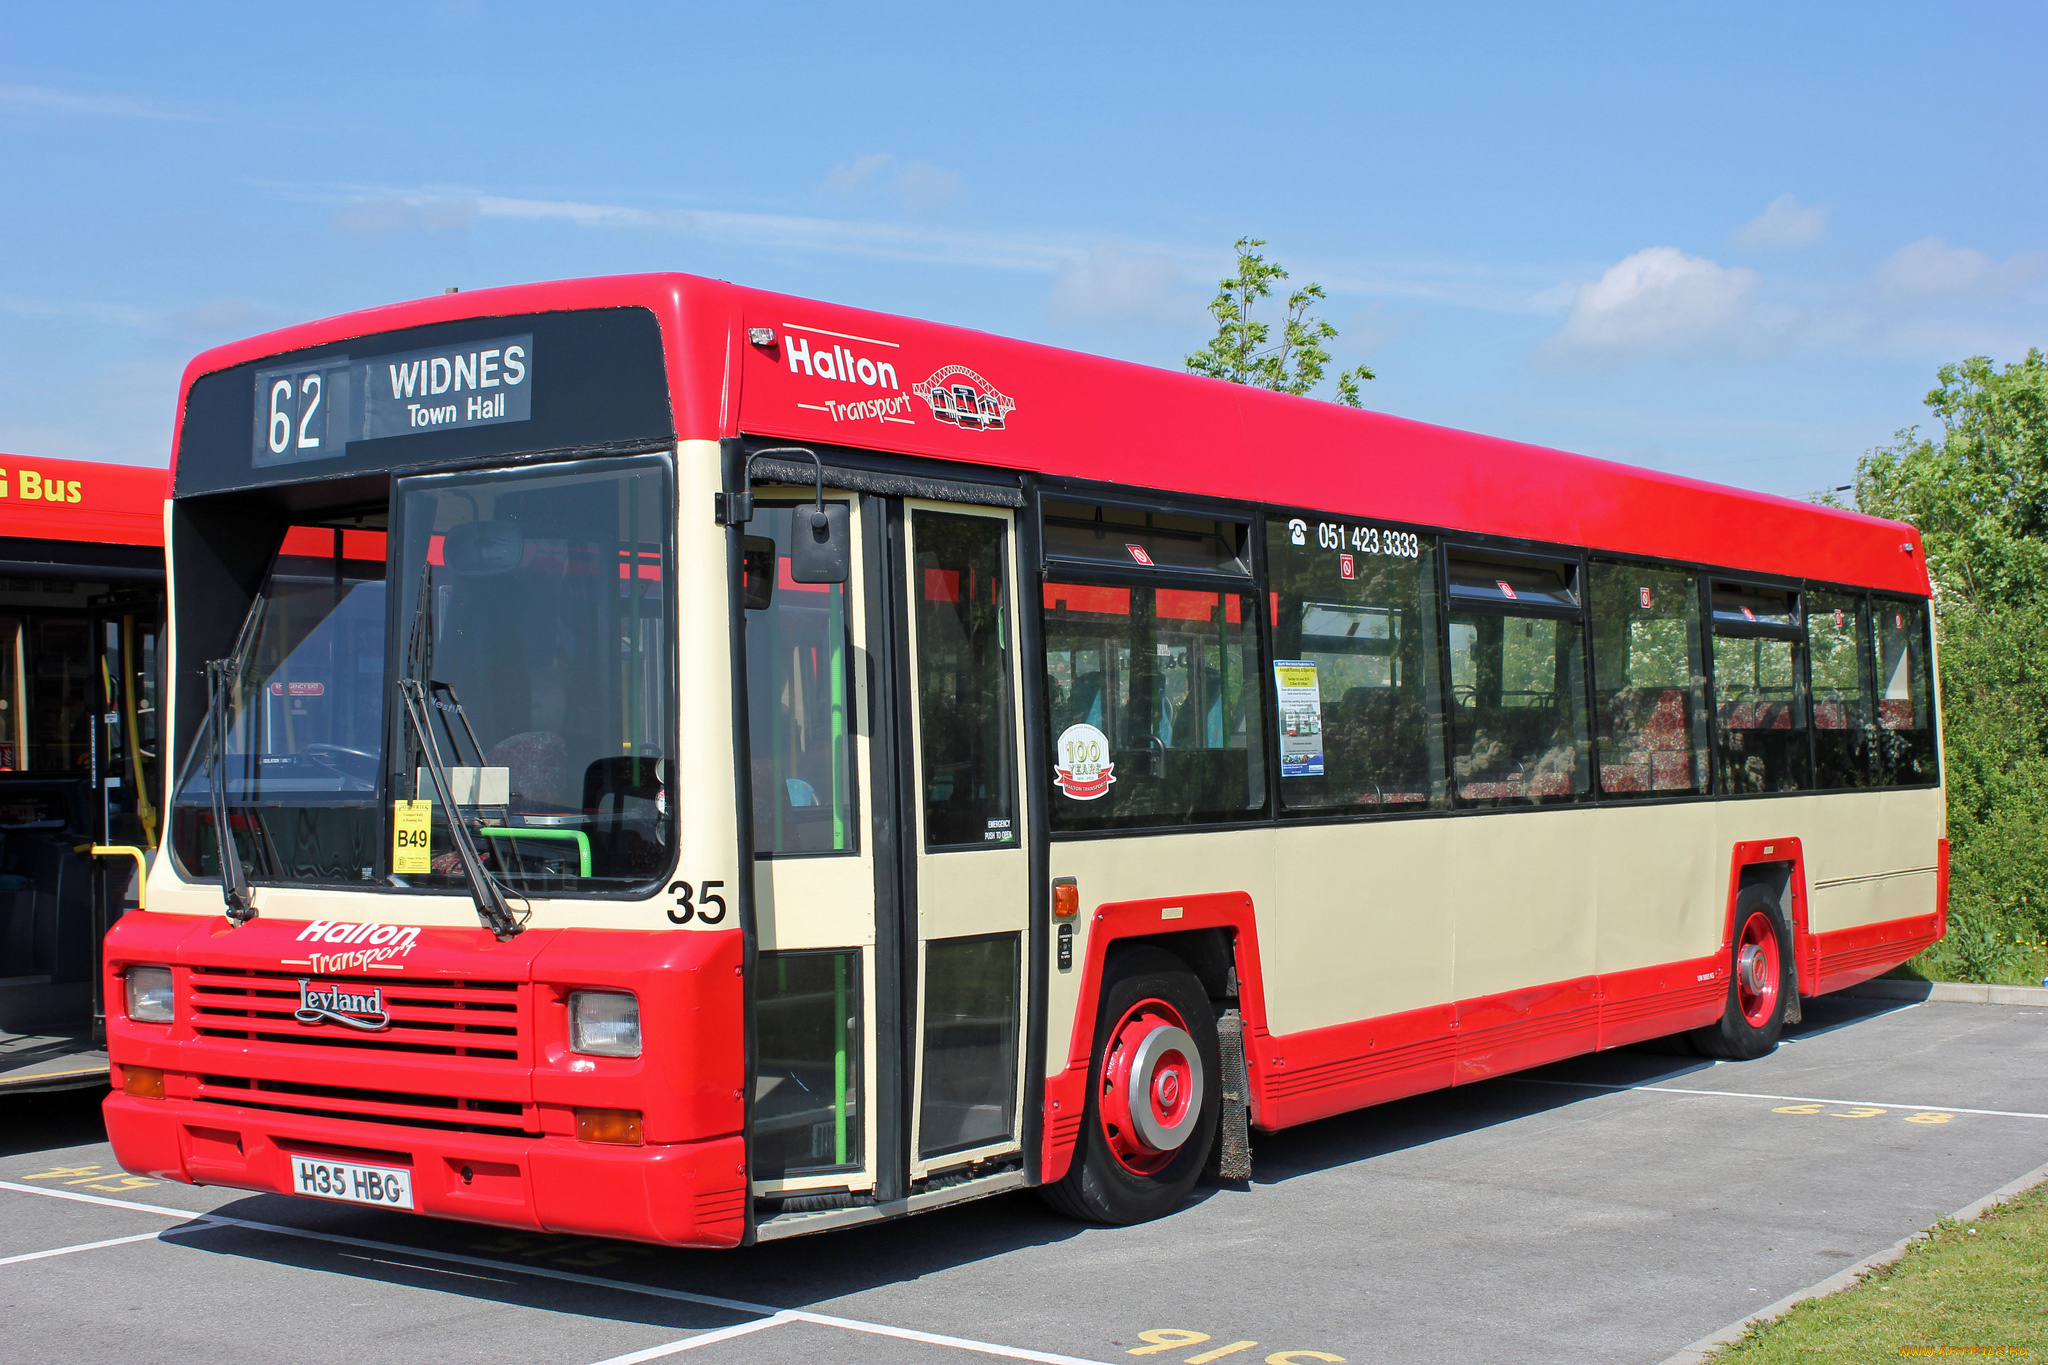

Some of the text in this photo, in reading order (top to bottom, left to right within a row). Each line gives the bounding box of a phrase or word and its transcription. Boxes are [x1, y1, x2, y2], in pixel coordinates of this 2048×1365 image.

[389, 345, 525, 400] WIDNES
[784, 335, 899, 390] Halton
[269, 374, 322, 453] 62
[407, 393, 505, 427] Town Hall
[824, 391, 912, 423] Transport
[19, 470, 82, 504] Bus
[1318, 522, 1419, 559] 051 423 3333
[1066, 740, 1100, 763] 100
[1068, 763, 1102, 776] YEARS
[1083, 780, 1107, 792] TRANSPORT
[398, 829, 428, 848] B49
[984, 831, 1013, 840] PUSH TO OPEN
[988, 819, 1011, 828] EMERGENCY
[666, 880, 727, 925] 35
[295, 919, 422, 946] Halton
[308, 940, 417, 974] Transport
[295, 978, 389, 1030] Leyland
[1771, 1103, 1956, 1124] 638
[301, 1162, 400, 1203] H35 HBG
